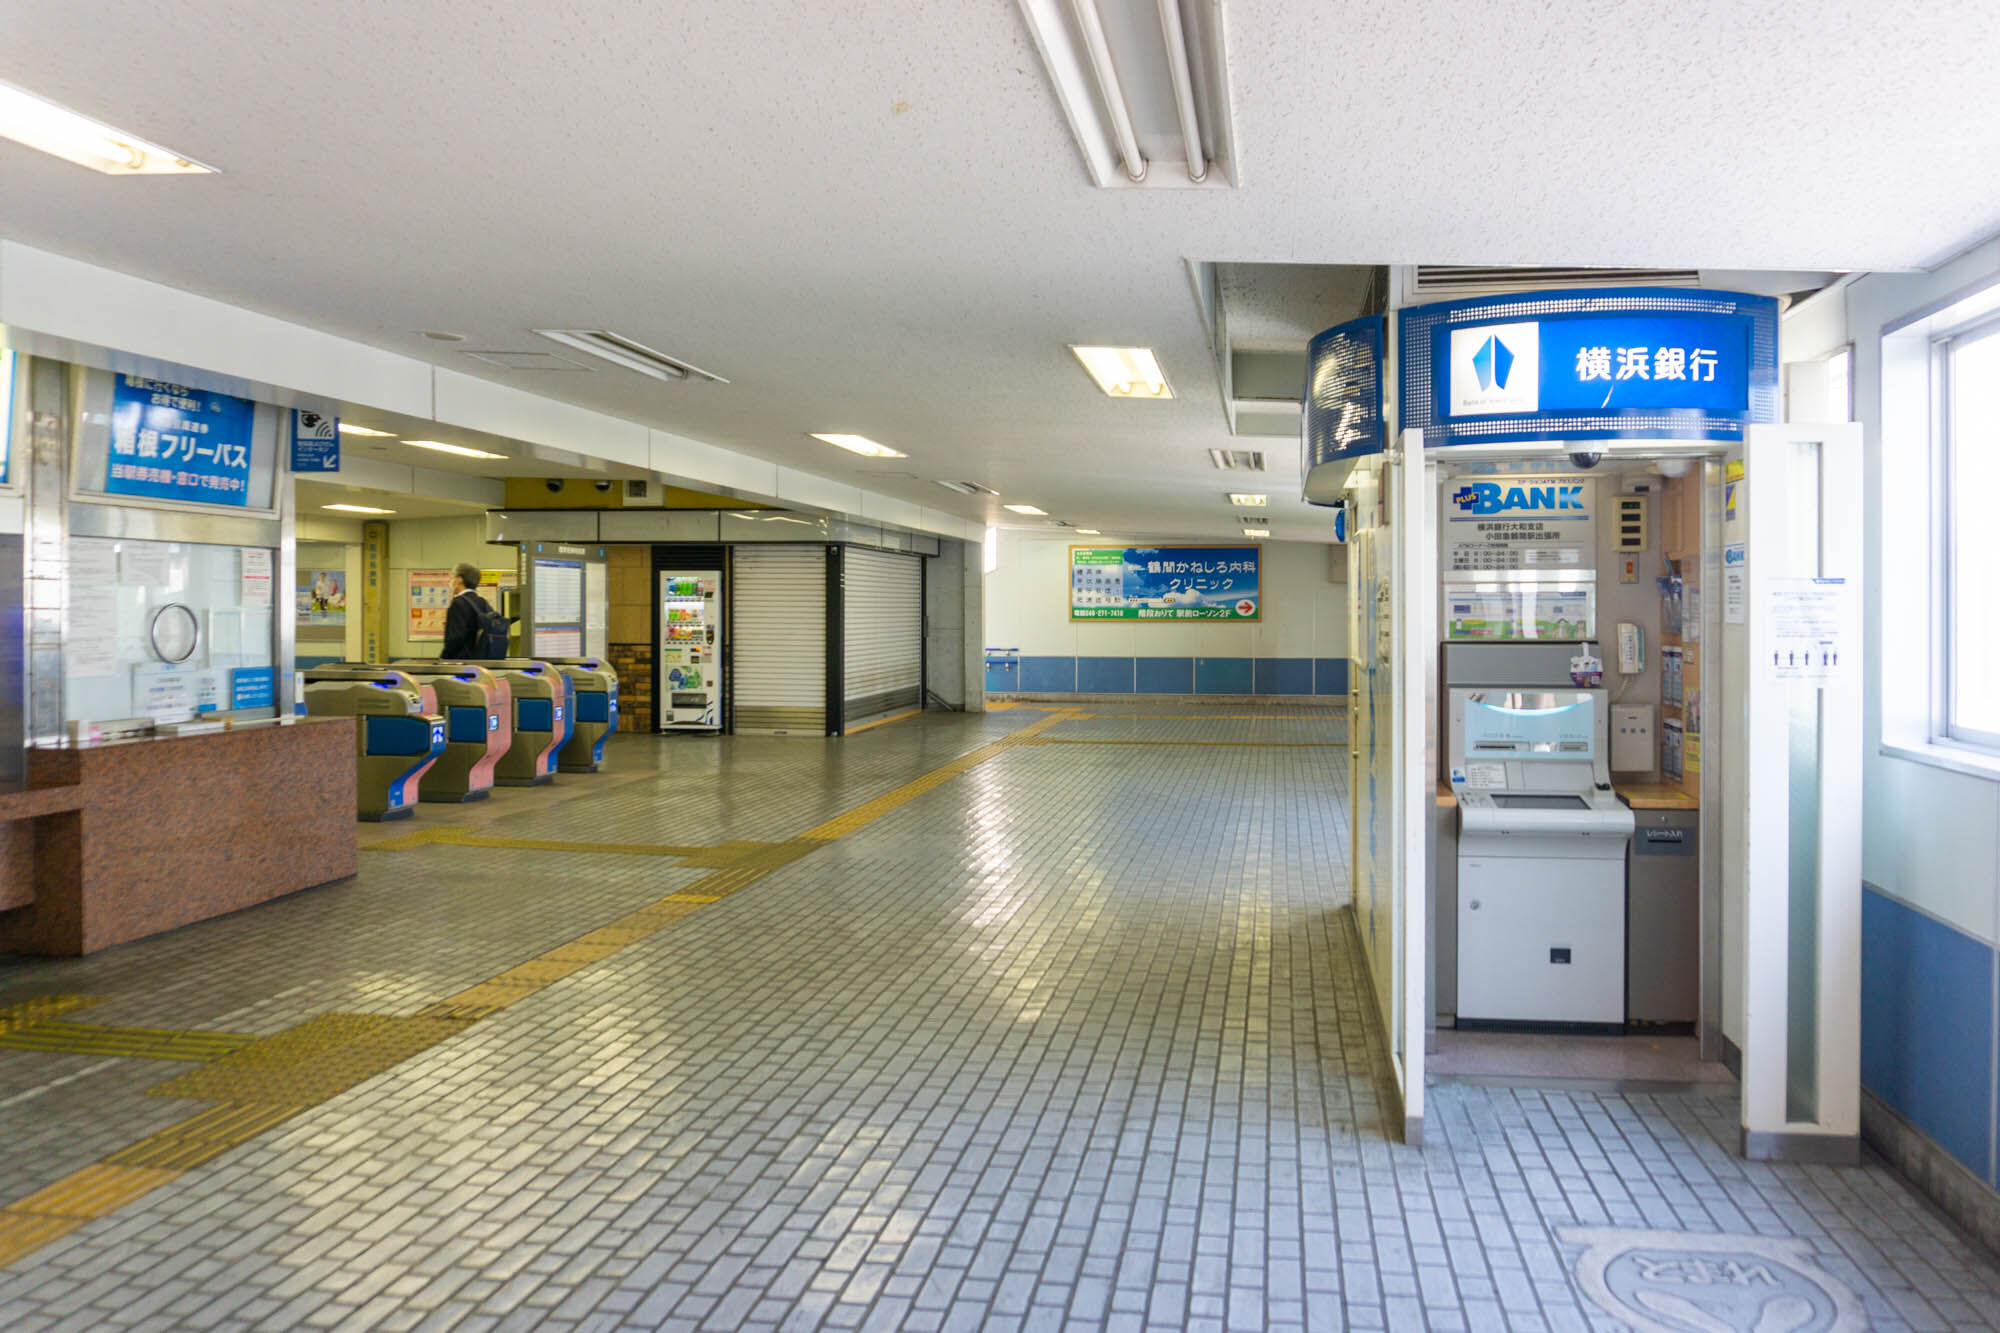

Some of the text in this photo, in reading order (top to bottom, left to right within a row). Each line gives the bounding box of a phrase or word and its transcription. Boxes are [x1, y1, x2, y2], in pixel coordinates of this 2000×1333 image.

[1576, 347, 1718, 382] 横浜銀行
[1455, 482, 1584, 515] PLUS BANK
[1147, 561, 1257, 574] 鶴間かねしろ内科
[1169, 578, 1234, 590] クリニック
